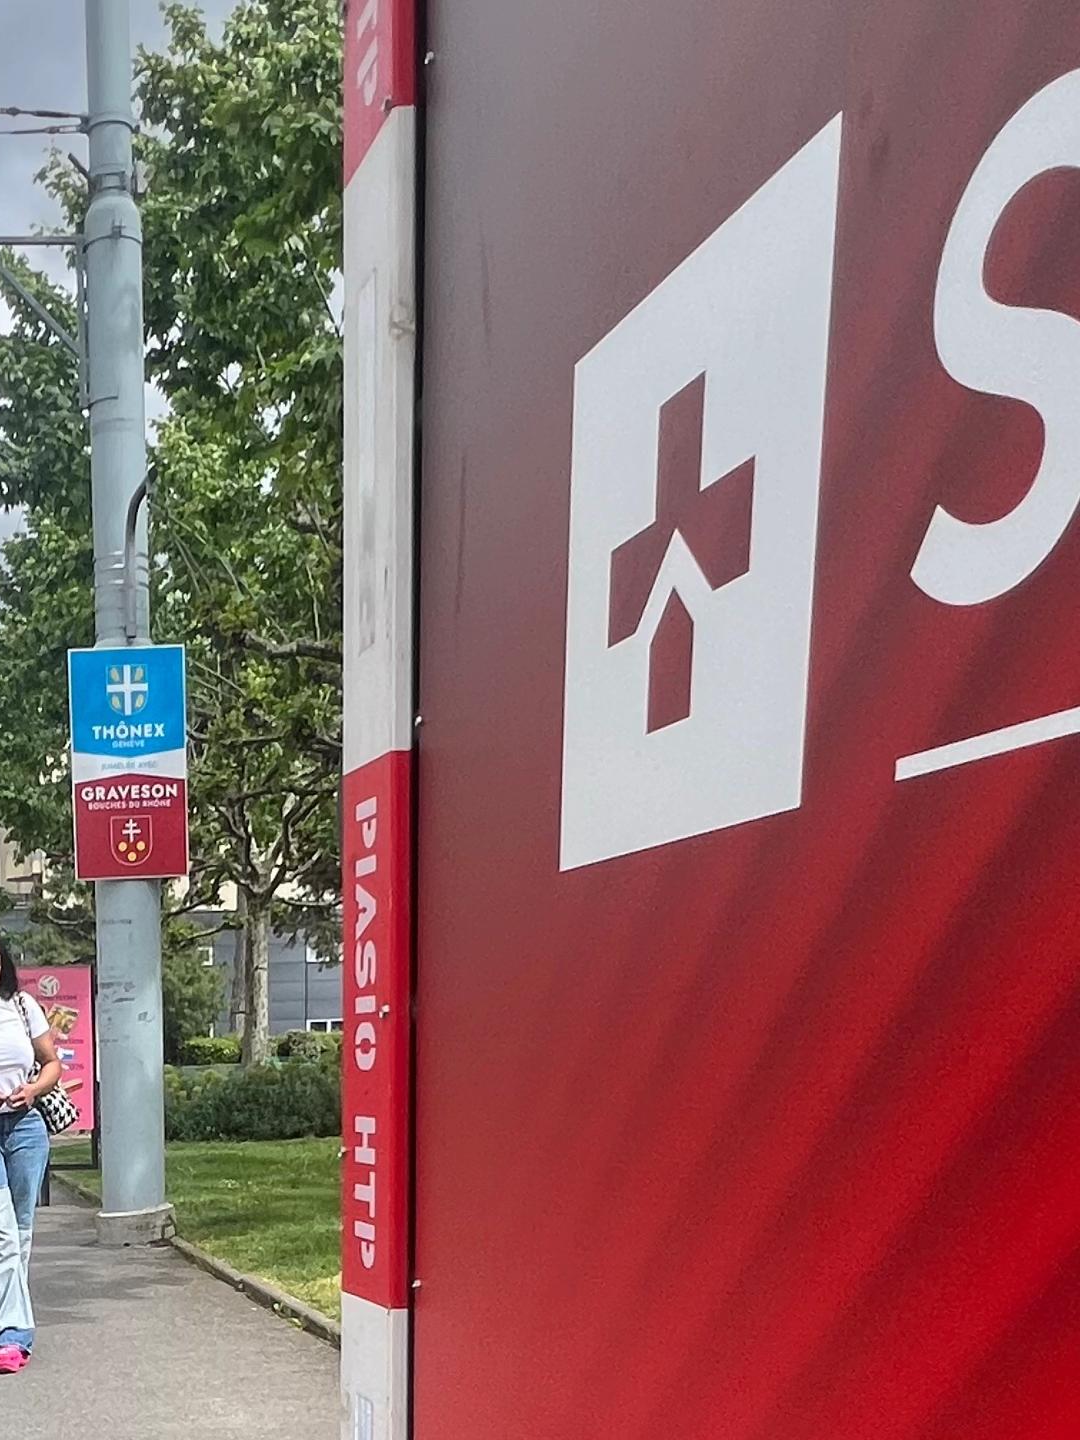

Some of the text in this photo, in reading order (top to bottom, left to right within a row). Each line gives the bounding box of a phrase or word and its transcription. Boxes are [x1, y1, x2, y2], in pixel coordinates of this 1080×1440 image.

[357, 0, 378, 107] TP
[92, 720, 165, 740] THÔNEX
[81, 784, 177, 801] GRAVESON
[354, 796, 377, 1269] PIASIO HTP
